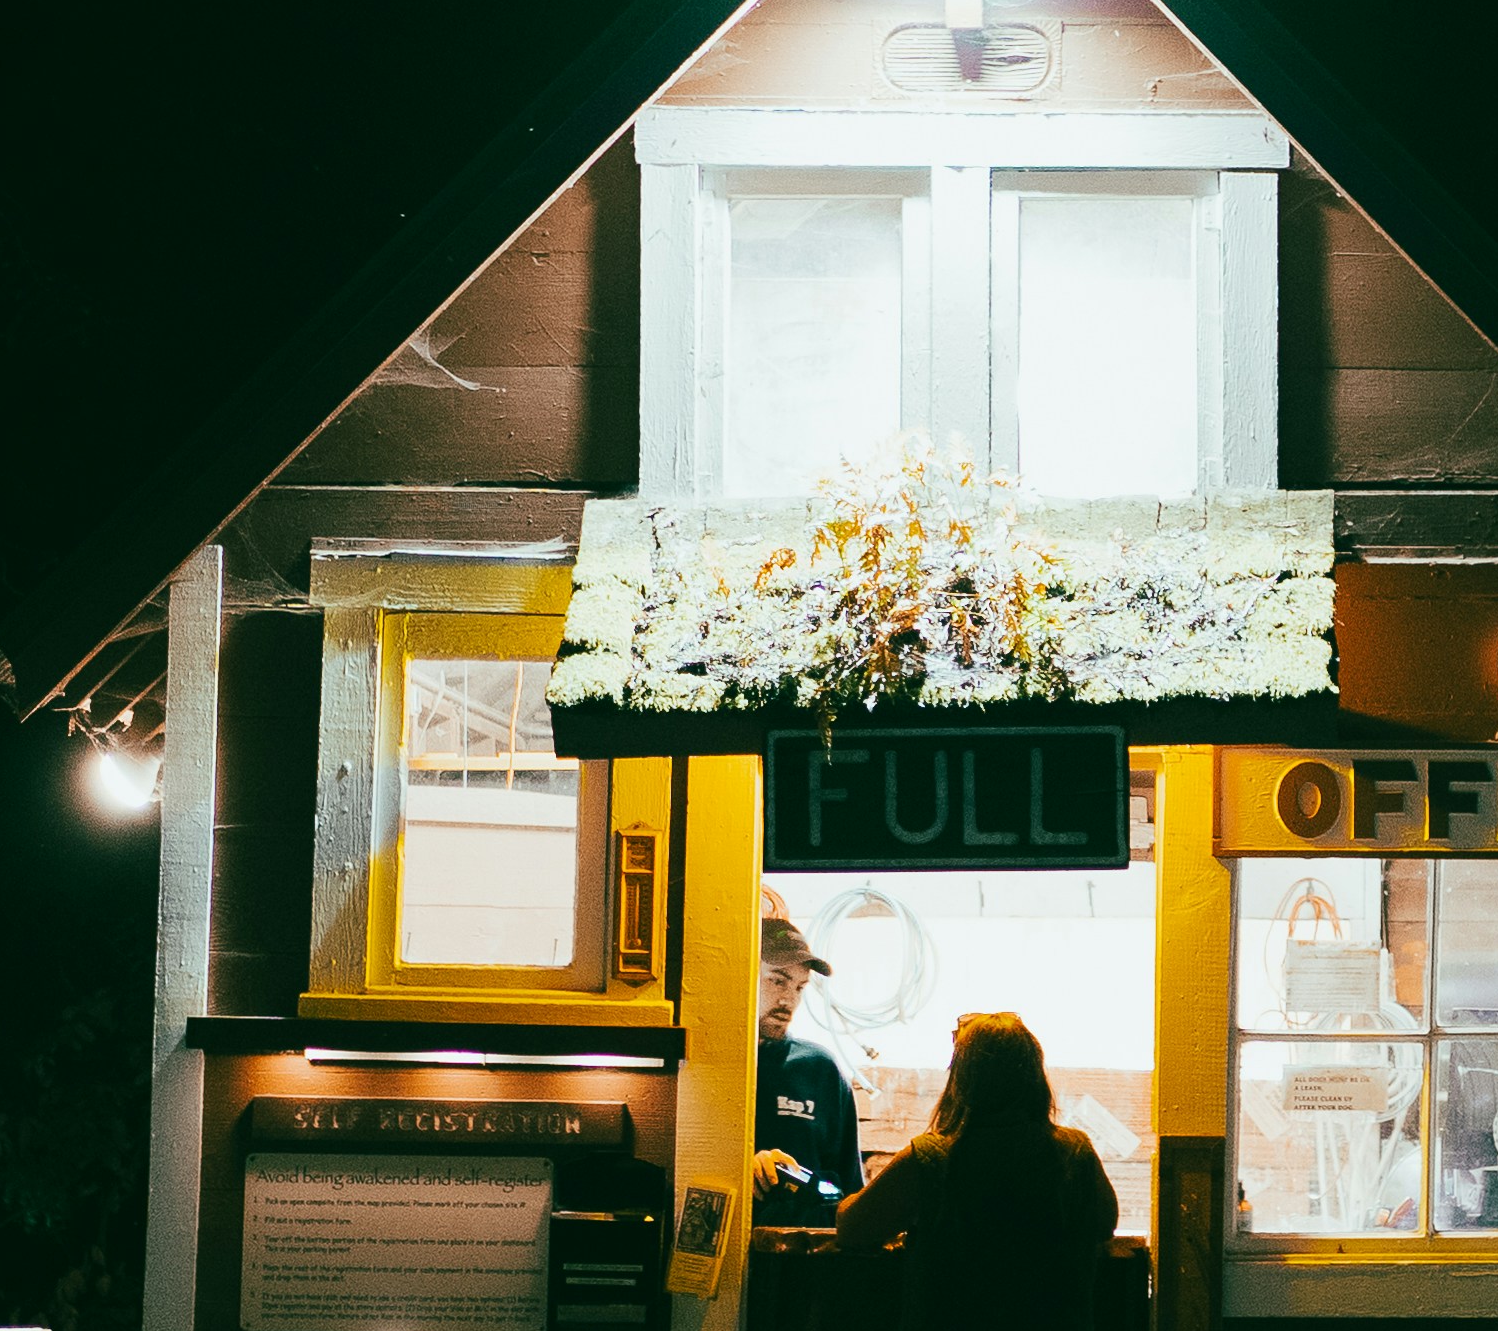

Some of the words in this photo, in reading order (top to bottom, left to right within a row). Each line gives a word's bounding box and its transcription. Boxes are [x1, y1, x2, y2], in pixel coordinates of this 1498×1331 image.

[808, 747, 1089, 847] FULL
[293, 1106, 361, 1130] SELF
[379, 1108, 582, 1134] REGISTRATION
[255, 1166, 299, 1185] Avoid
[302, 1166, 344, 1189] being
[346, 1168, 420, 1186] awakened
[423, 1168, 453, 1187] and
[454, 1168, 546, 1193] self-register
[452, 1200, 464, 1208] off
[465, 1201, 480, 1209] your
